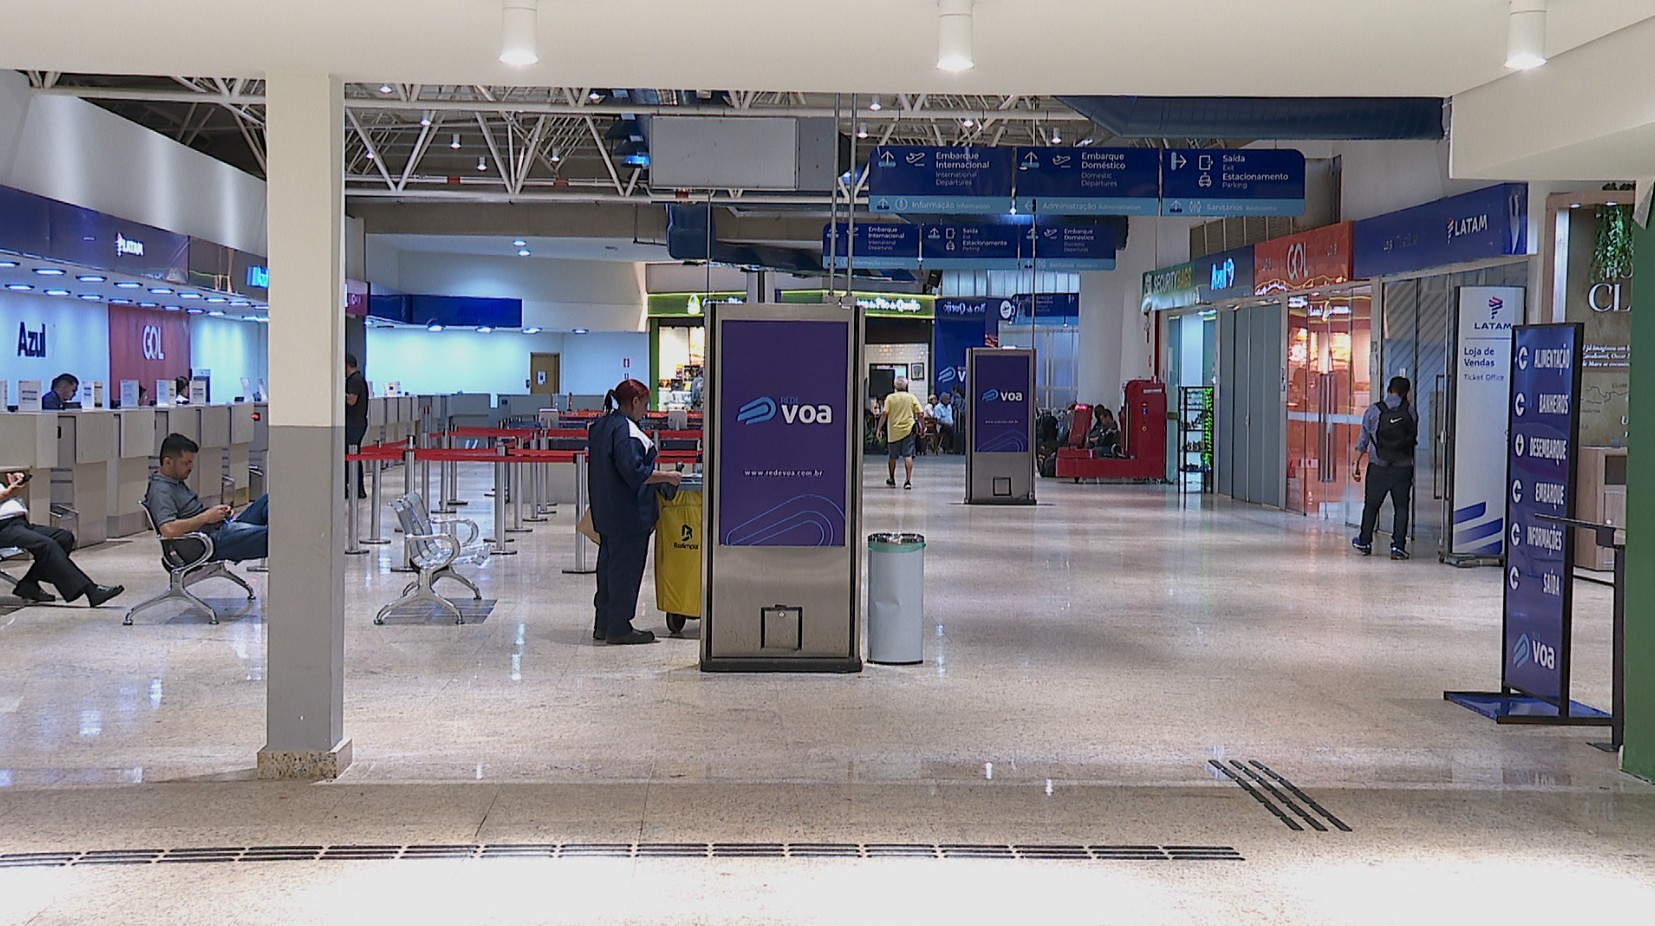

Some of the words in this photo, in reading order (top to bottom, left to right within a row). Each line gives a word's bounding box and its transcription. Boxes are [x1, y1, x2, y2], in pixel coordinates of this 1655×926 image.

[936, 152, 979, 161] Embarque
[1081, 152, 1125, 161] Embarque
[1222, 154, 1246, 163] Saída
[936, 161, 990, 169] Internacional
[1081, 161, 1126, 170] Doméstico
[936, 171, 978, 179] International
[1222, 173, 1289, 181] Estacionamento
[1081, 180, 1118, 188] Departures
[912, 201, 955, 211] Informação
[1042, 202, 1097, 211] Administração
[1206, 203, 1243, 211] Sanitários
[1454, 214, 1488, 236] LATAM
[1286, 242, 1309, 280] GOL
[1210, 261, 1227, 291] Azul
[1474, 322, 1512, 330] LATAM
[17, 321, 46, 358] Azul
[142, 325, 165, 360] GOL
[1464, 347, 1482, 358] Loja
[1484, 347, 1495, 356] de
[1464, 358, 1495, 367] Vendas
[1533, 342, 1571, 376] ALIMENTAÇÃO
[1000, 392, 1023, 401] voa
[1538, 393, 1569, 415] BANHEIROS
[781, 404, 832, 424] voa
[1529, 436, 1567, 466] DESEMBARQUE
[744, 469, 823, 477] www.redevoa.com.br
[1535, 482, 1565, 510] EMBARQUE
[1526, 524, 1563, 556] INFORMAÇÕES
[1542, 569, 1560, 596] SAÍDA
[1532, 639, 1555, 670] voa
